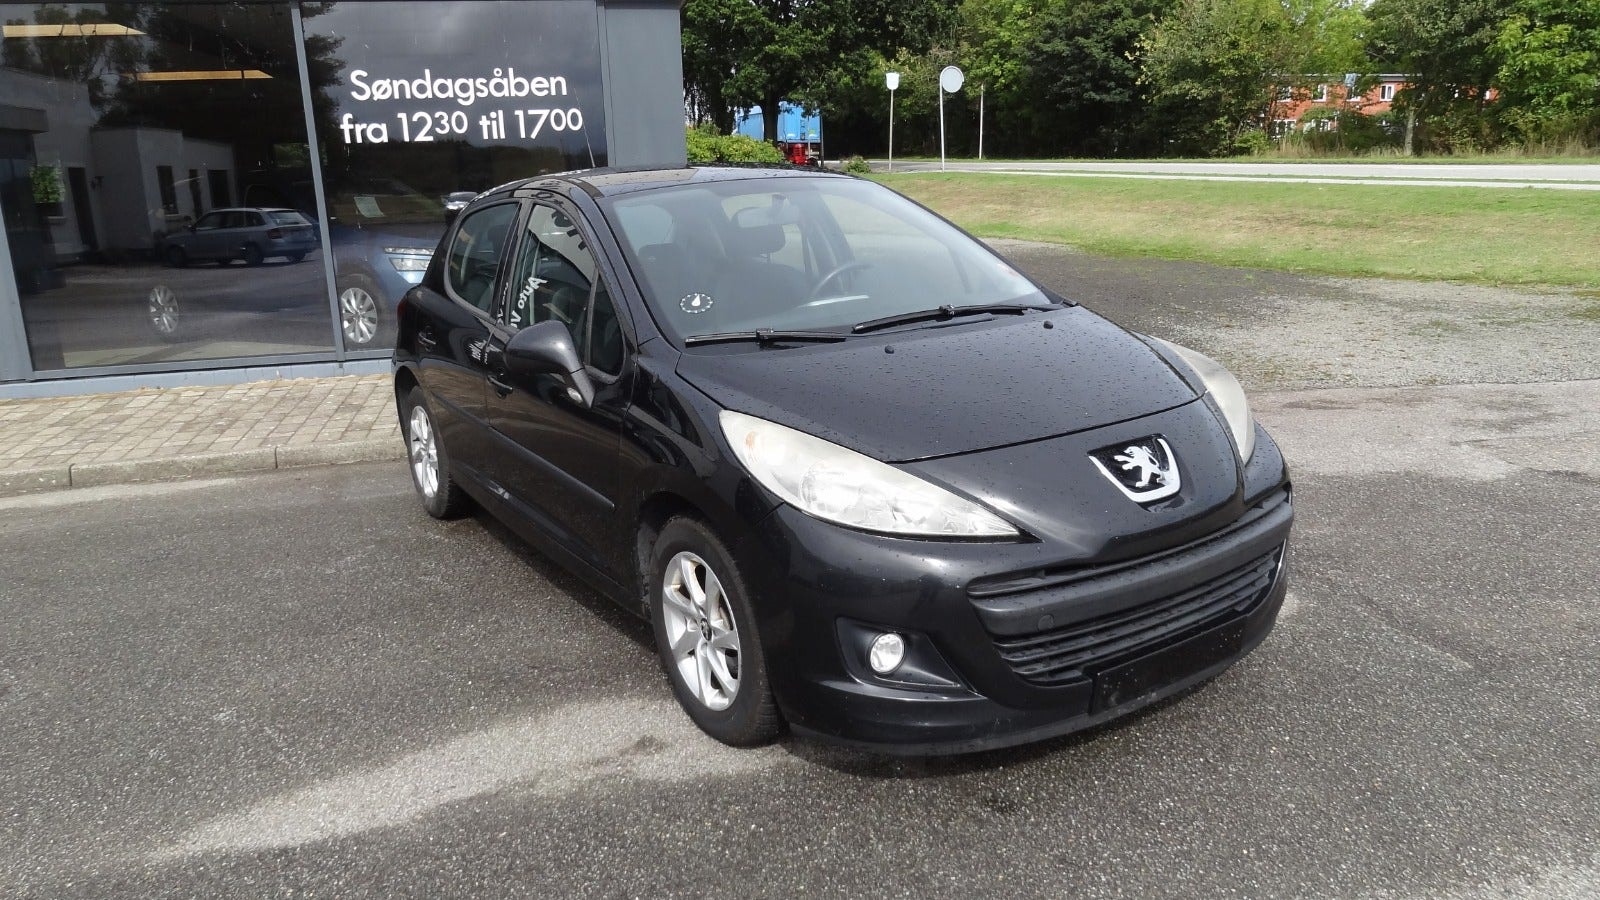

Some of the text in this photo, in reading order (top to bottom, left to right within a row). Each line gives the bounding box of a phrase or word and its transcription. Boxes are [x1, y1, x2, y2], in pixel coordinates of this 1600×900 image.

[350, 68, 567, 105] Søndagsåben
[340, 108, 582, 143] fra 1230 til 1700
